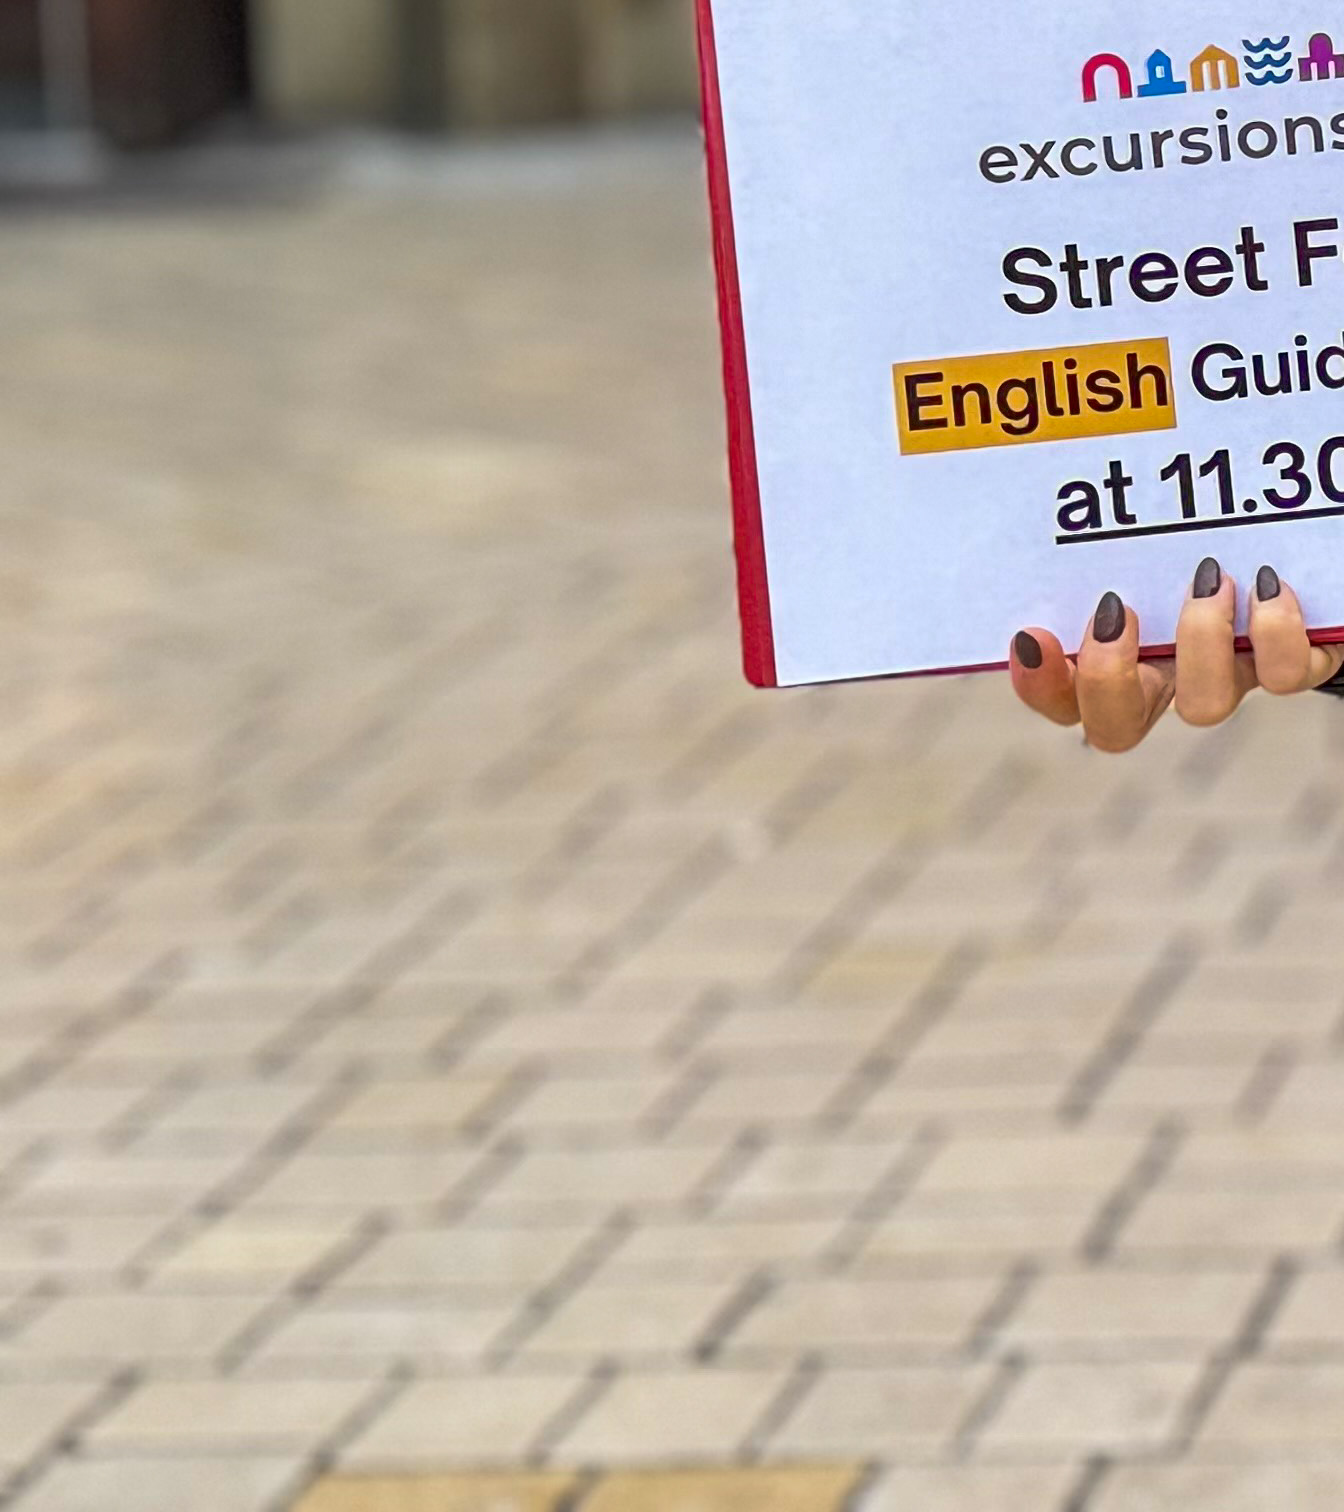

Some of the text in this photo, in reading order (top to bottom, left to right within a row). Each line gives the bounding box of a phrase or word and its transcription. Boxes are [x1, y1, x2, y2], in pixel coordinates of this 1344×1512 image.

[1002, 226, 1269, 315] Street
[904, 352, 1168, 436] English
[1056, 460, 1137, 532] at
